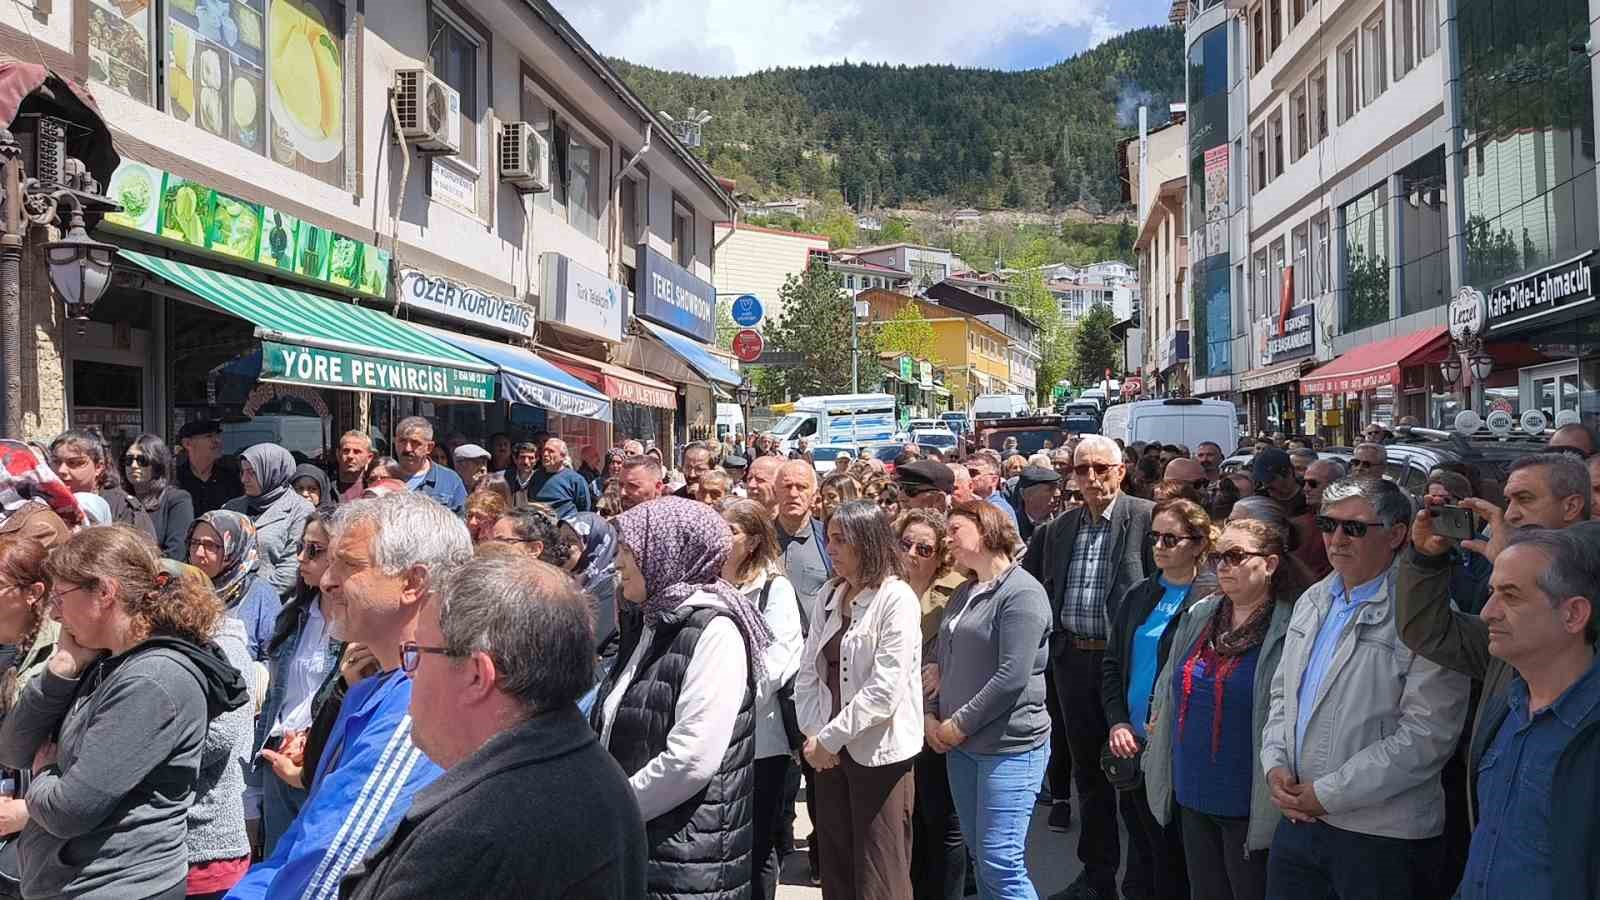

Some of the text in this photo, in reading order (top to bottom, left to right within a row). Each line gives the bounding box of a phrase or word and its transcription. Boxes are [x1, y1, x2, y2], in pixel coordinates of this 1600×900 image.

[458, 287, 530, 332] KURUYEMİŞ
[576, 282, 609, 310] Türk Telekom
[652, 272, 711, 323] TEKEL SHOWROOM
[282, 347, 448, 393] YÖRE PEYNİRCİSİ
